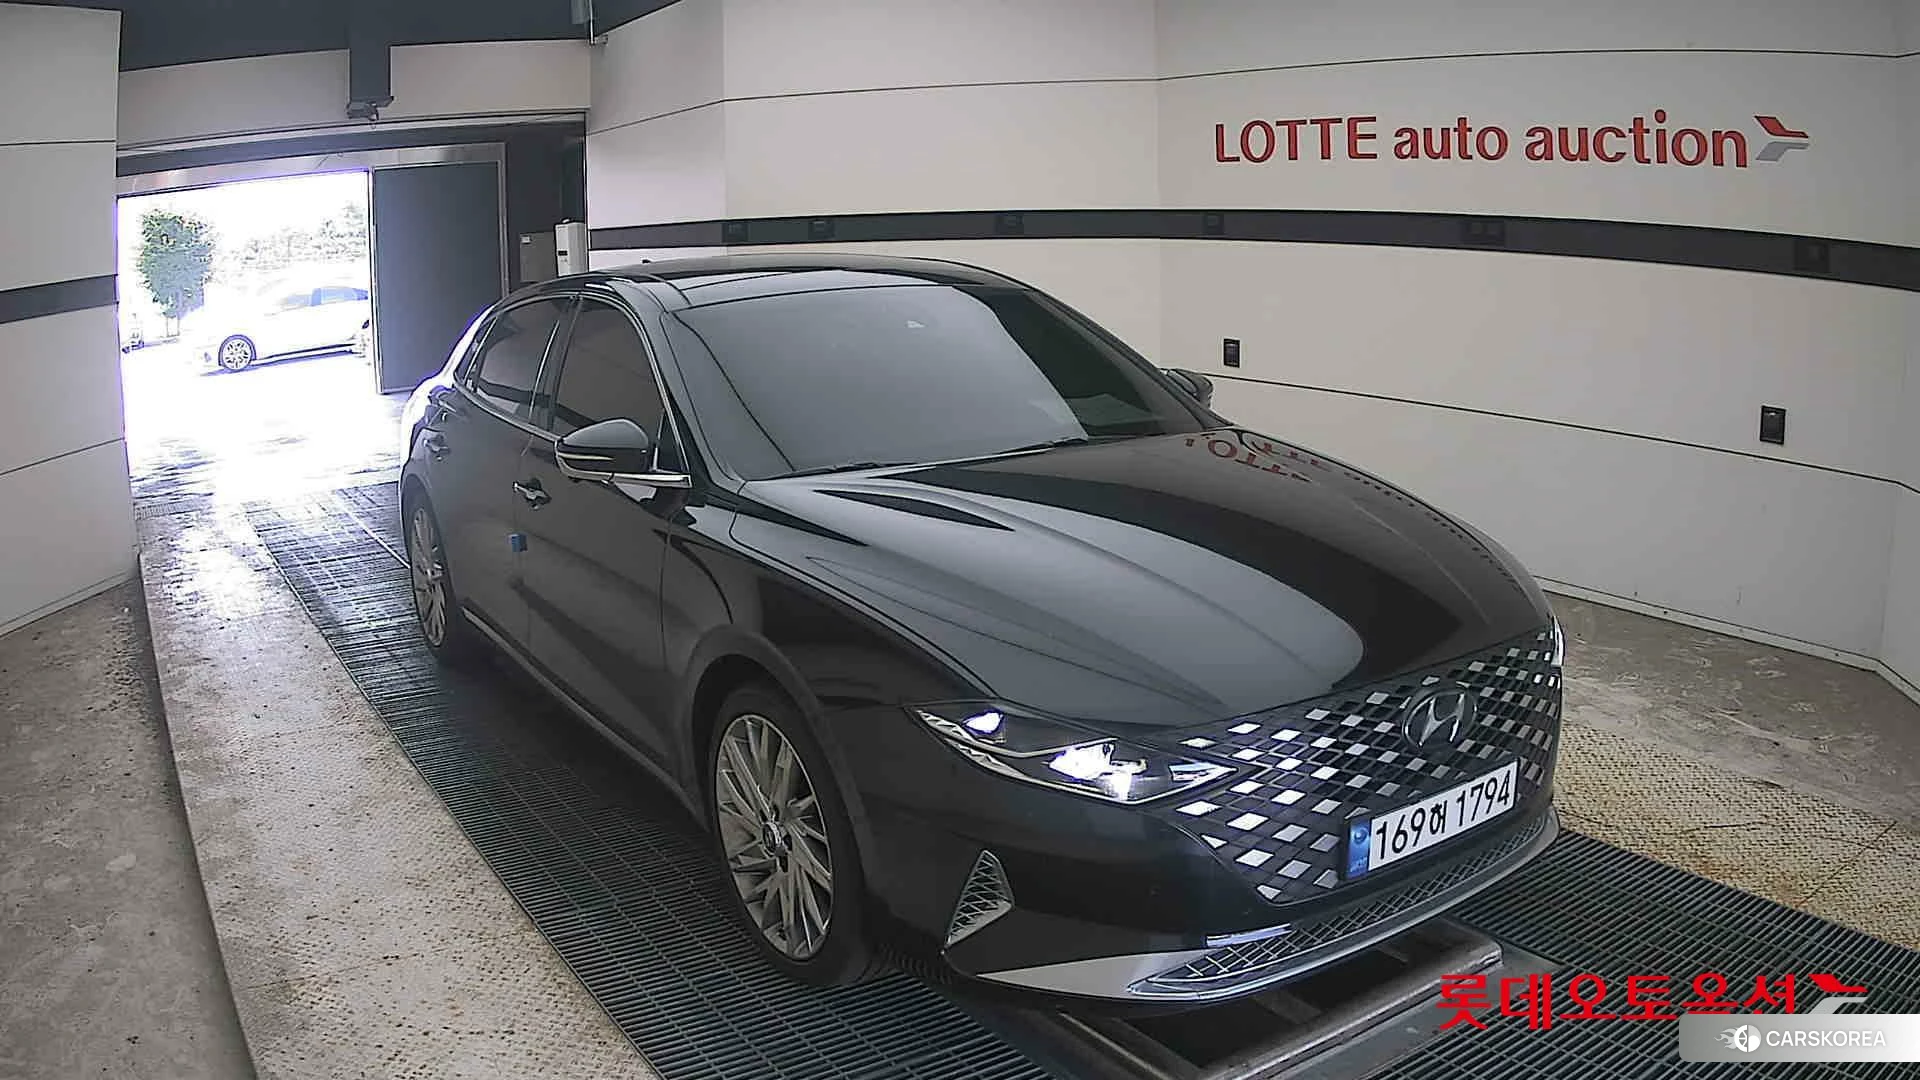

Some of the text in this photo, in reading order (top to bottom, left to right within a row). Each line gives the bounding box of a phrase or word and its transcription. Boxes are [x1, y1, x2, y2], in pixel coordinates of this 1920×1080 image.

[1215, 109, 1749, 168] LOTTE auto auction
[1456, 770, 1511, 827] 1794
